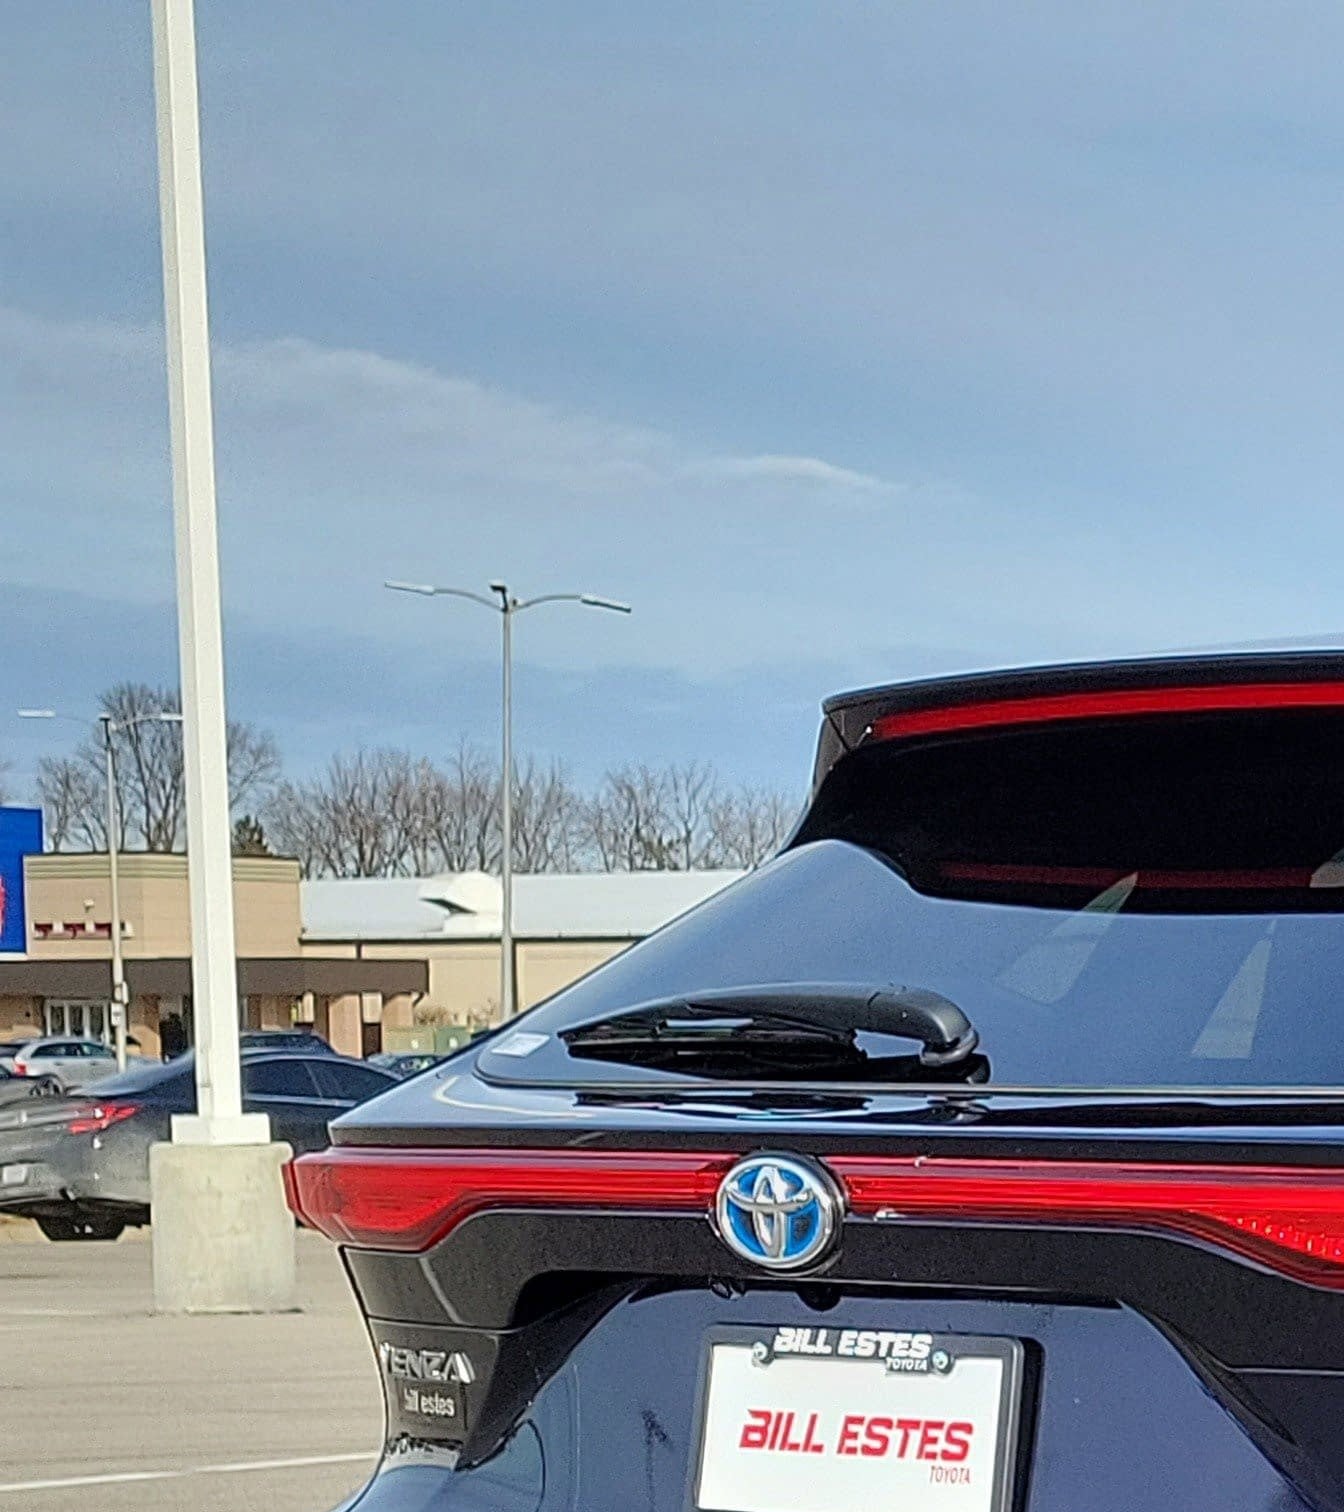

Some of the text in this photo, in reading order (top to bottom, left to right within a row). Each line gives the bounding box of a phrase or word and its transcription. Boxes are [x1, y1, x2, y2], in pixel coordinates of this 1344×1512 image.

[773, 1327, 932, 1358] BILL ESTES
[886, 1358, 928, 1372] TOYOTA
[420, 1391, 455, 1417] estes
[739, 1408, 974, 1462] BILL ESTES
[929, 1465, 971, 1484] TOYOTA
